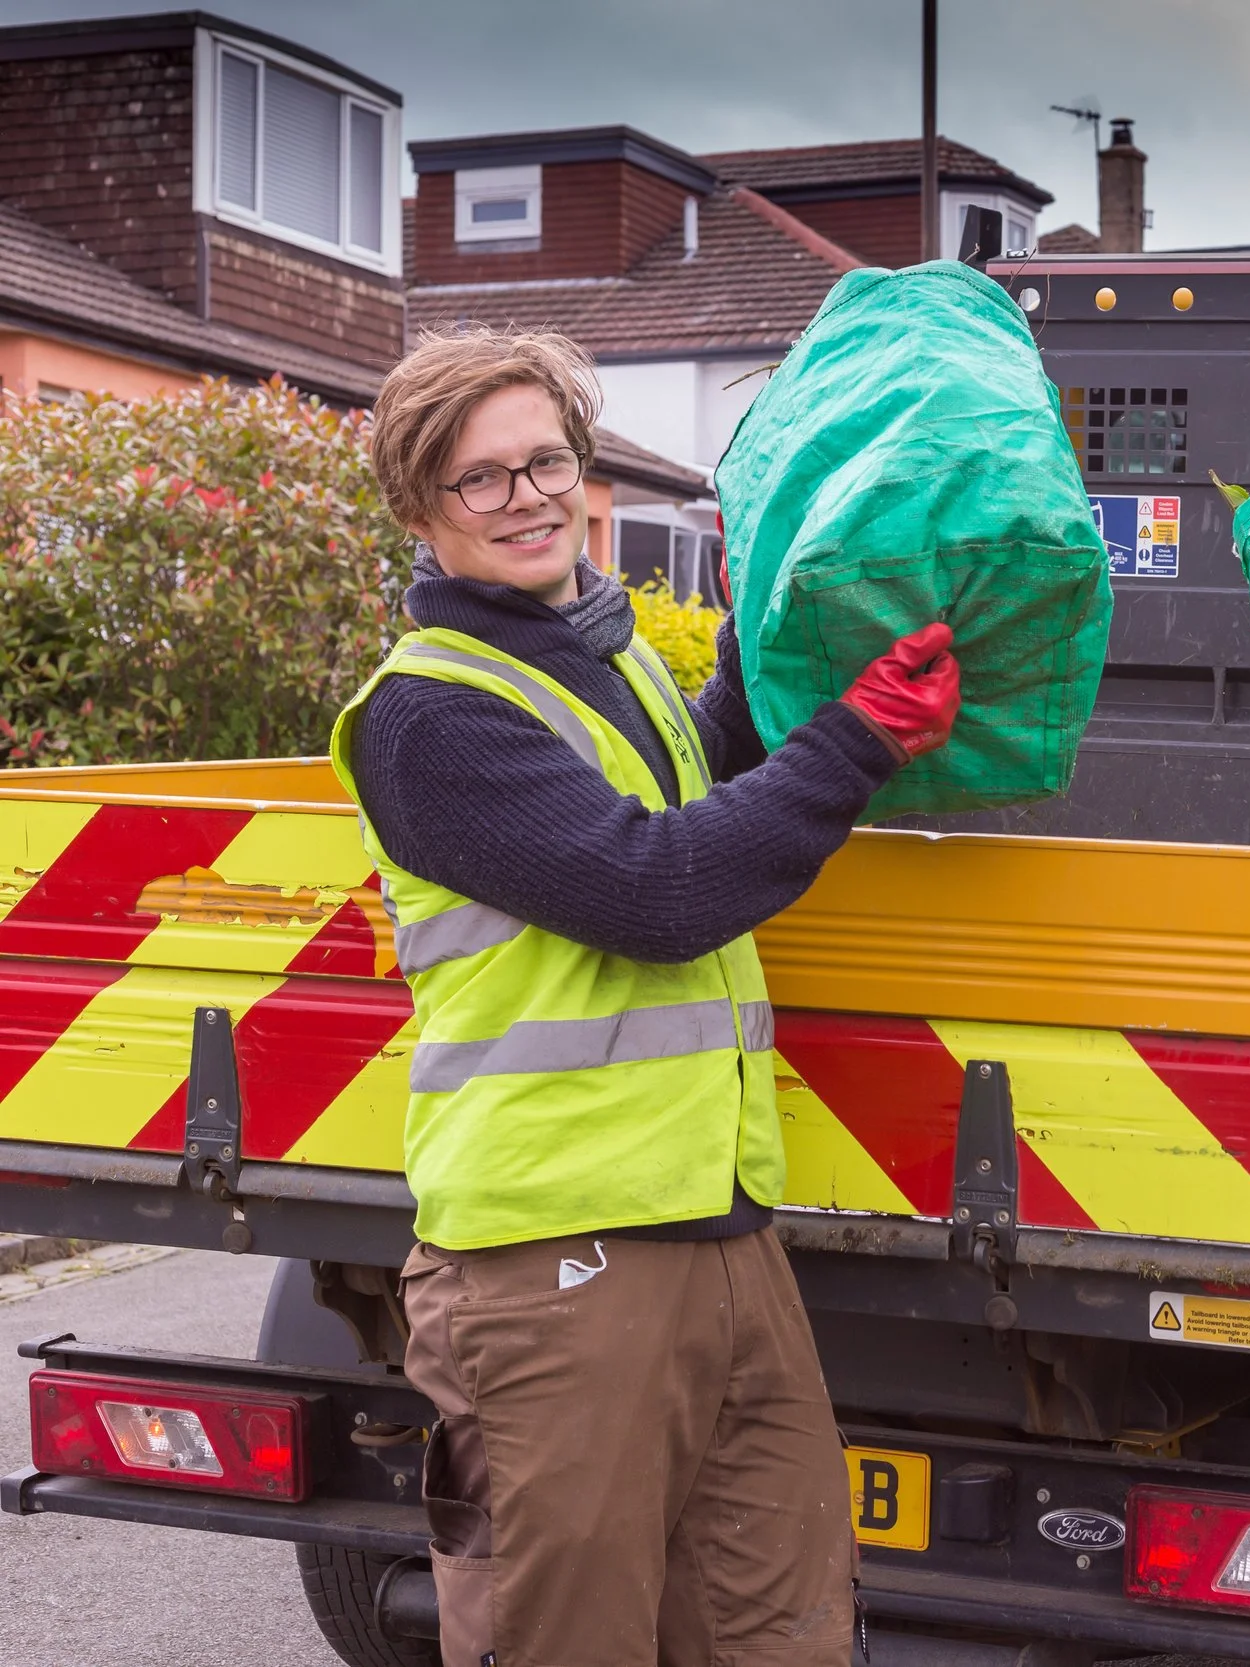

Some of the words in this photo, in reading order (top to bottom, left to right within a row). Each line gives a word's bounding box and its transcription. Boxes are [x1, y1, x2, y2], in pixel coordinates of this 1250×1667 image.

[1191, 1310, 1218, 1319] Tailboard
[1226, 1313, 1250, 1322] lowered
[1204, 1319, 1231, 1328] lowering
[1192, 1327, 1217, 1335] warning
[1217, 1327, 1240, 1337] triangle
[858, 1458, 899, 1531] B
[1056, 1516, 1108, 1543] Ford
